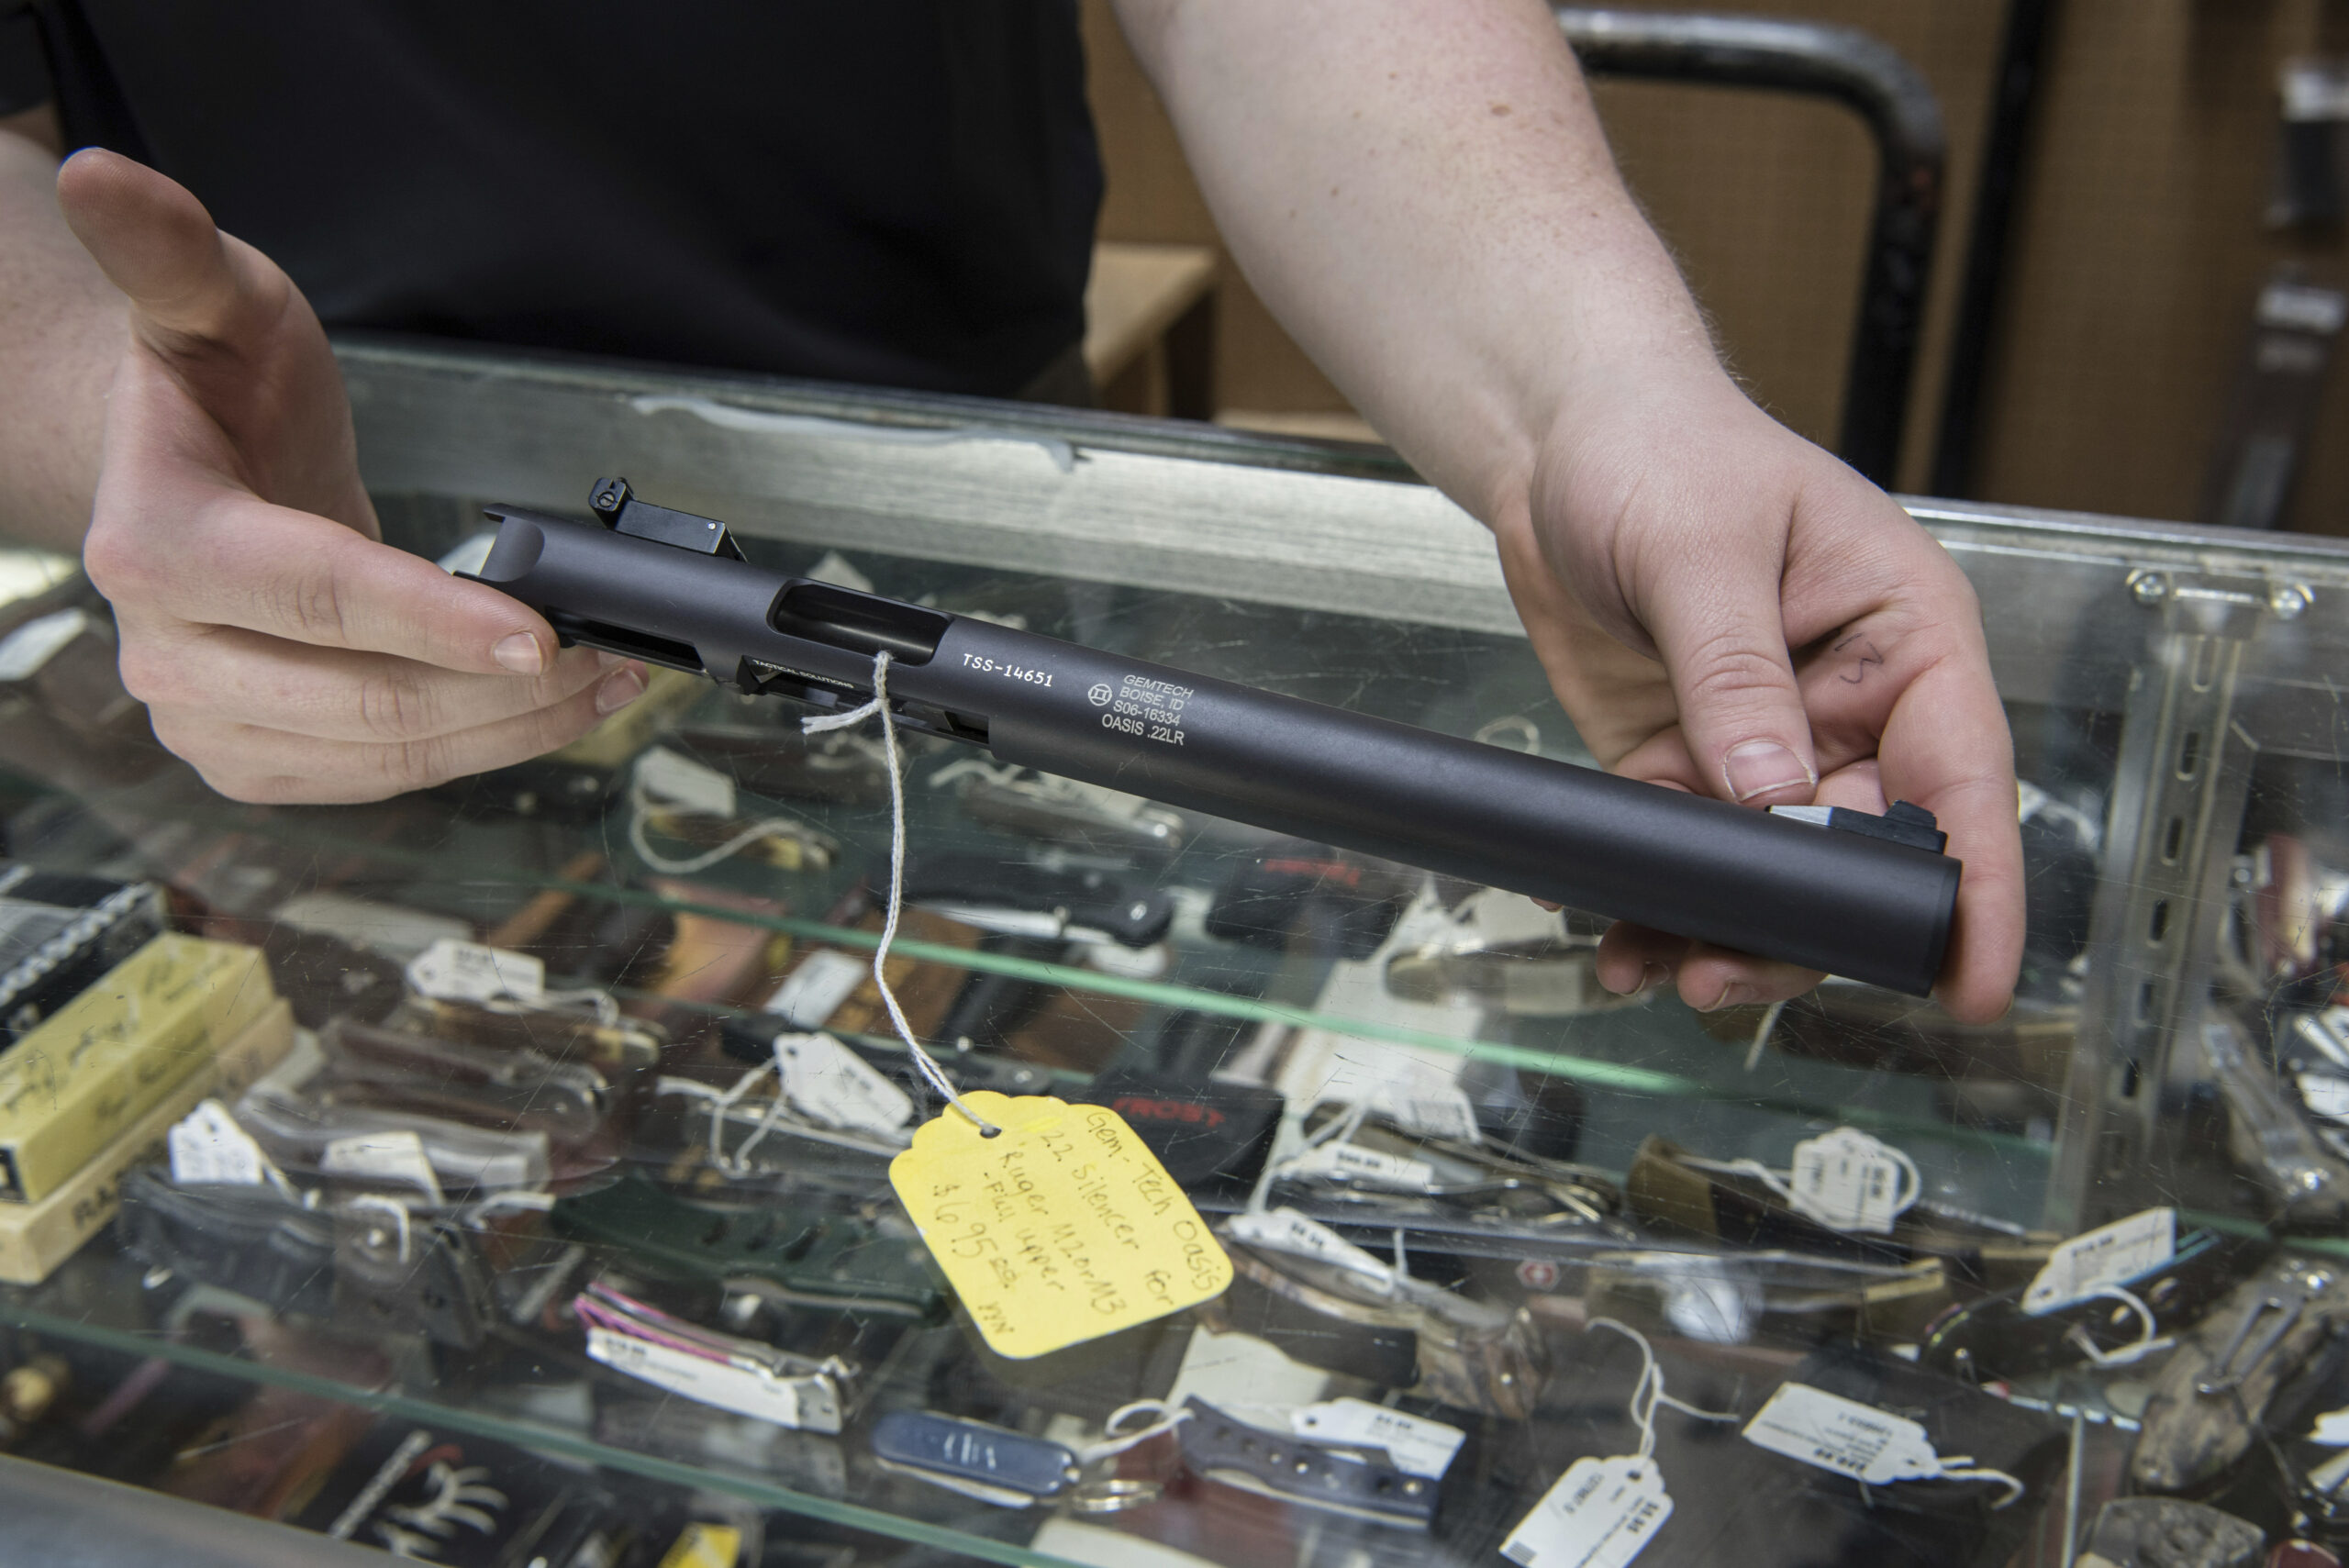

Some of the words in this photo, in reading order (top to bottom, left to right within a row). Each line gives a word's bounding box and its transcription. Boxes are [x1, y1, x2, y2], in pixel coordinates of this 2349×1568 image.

[963, 653, 1053, 687] TSS-14651
[1123, 674, 1195, 699] GEMTECH
[1113, 699, 1182, 727] S06-16334
[1119, 686, 1164, 708] BOISE,
[1168, 697, 1185, 711] ID
[1101, 713, 1144, 736] OASIS
[1146, 726, 1186, 746] .22LR
[998, 1151, 1049, 1216] Ruger
[1071, 1162, 1140, 1251] Silencer
[1173, 1220, 1220, 1291] Oasis
